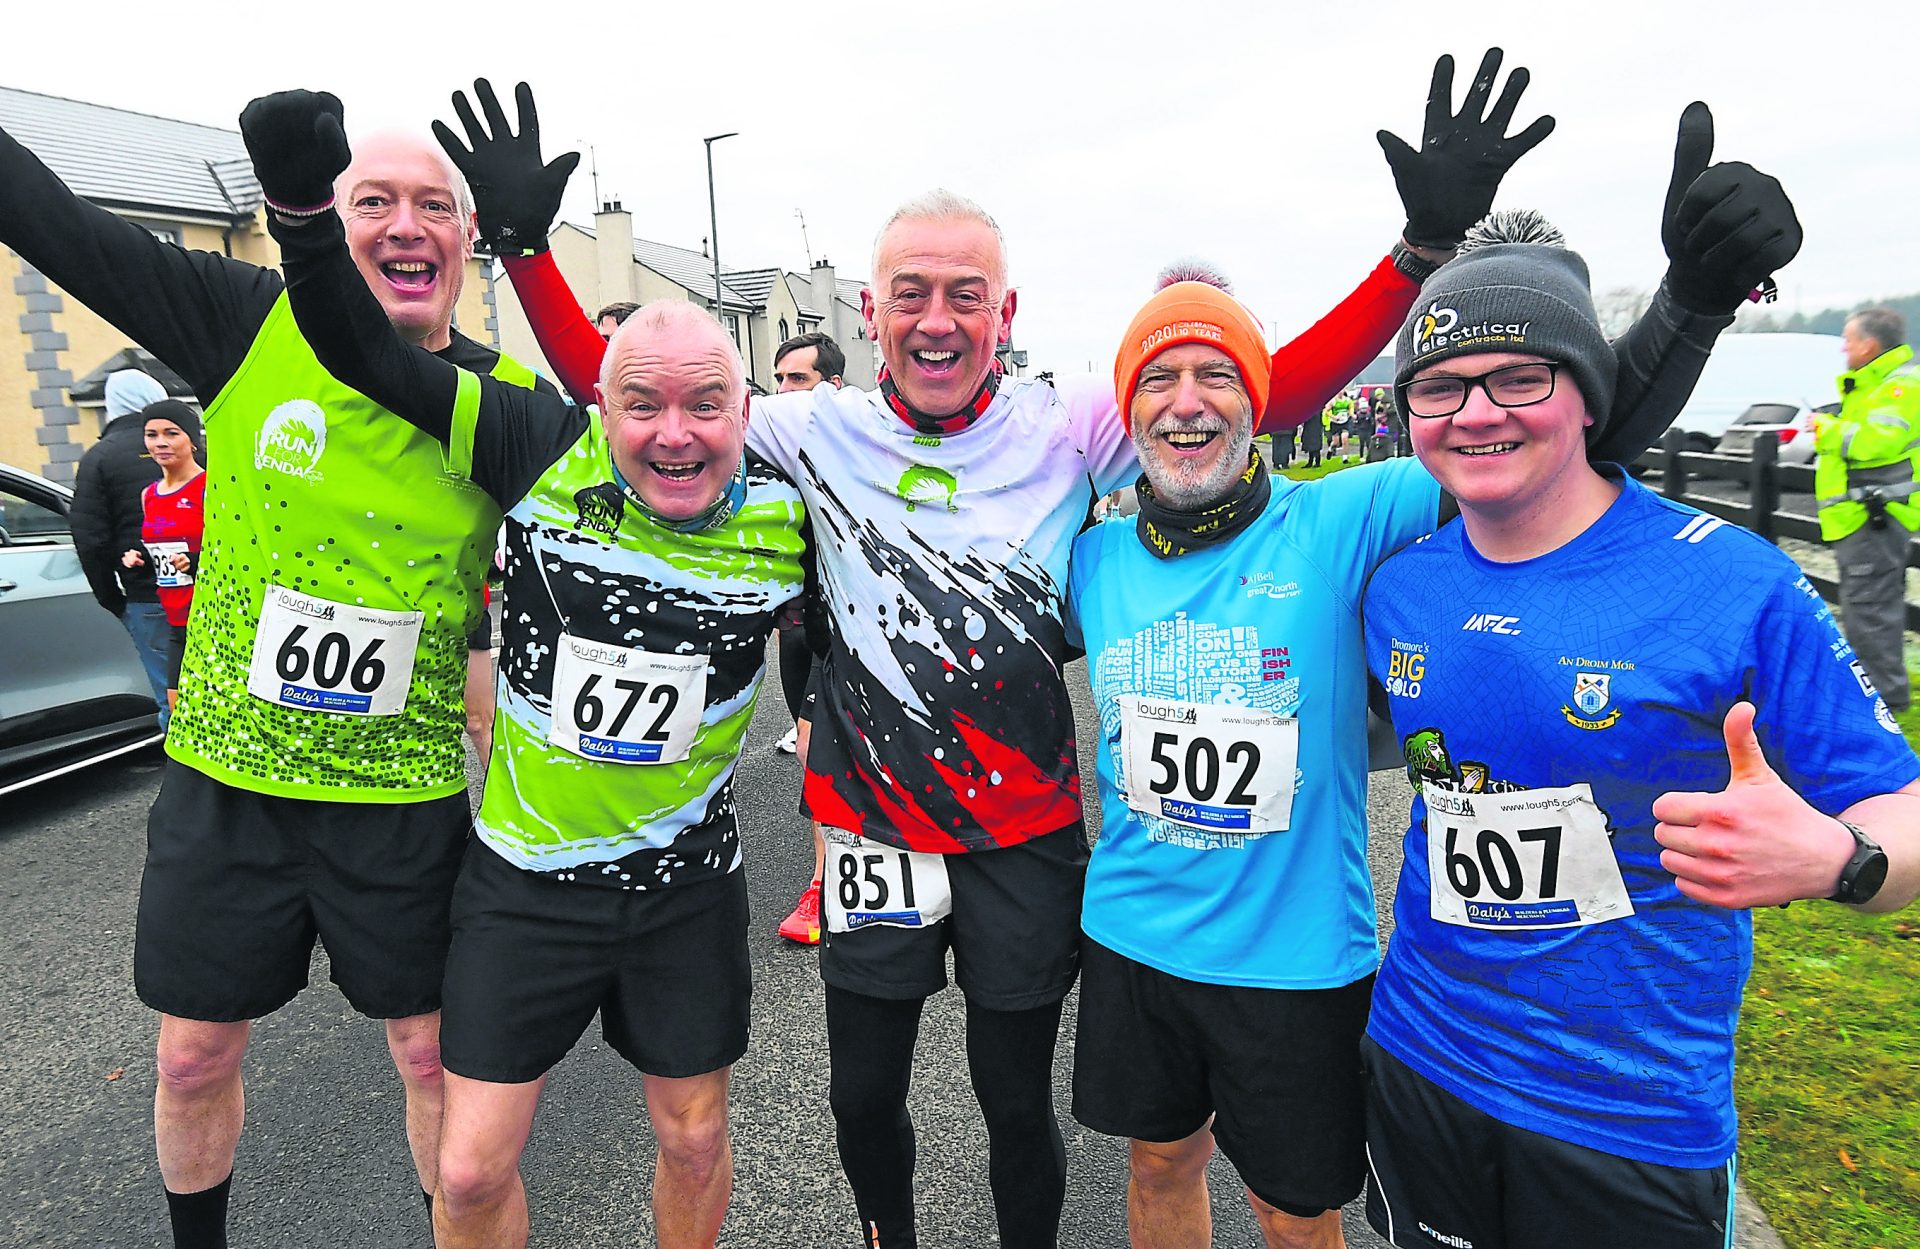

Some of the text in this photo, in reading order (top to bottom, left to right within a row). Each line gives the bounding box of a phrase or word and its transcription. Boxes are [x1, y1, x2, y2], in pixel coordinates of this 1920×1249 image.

[1141, 326, 1172, 353] 2020
[1179, 327, 1222, 341] 10 YEARS
[1421, 316, 1531, 352] electrical
[1457, 334, 1525, 348] contracts ltd
[270, 428, 314, 457] RUN
[273, 446, 303, 465] FOR
[261, 455, 304, 479] ENDA
[583, 502, 618, 521] RUN
[580, 516, 615, 536] ENDA
[1247, 581, 1298, 598] great north
[278, 591, 323, 613] lough5
[358, 616, 417, 627] www.lough5.com
[1117, 638, 1133, 647] WE
[1195, 629, 1230, 639] COME
[570, 641, 616, 662] lough5
[1107, 647, 1133, 657] RUN
[1195, 636, 1231, 652] ON
[1261, 647, 1289, 658] FIN
[1391, 637, 1430, 654] Dromore's
[275, 624, 386, 694] 606
[1106, 656, 1133, 667] FOR
[1134, 630, 1144, 692] WAVING
[1196, 650, 1261, 660] EVERY ONE
[1196, 657, 1261, 669] OF US IS
[1105, 666, 1133, 675] EACH
[1196, 666, 1261, 677] A STORY
[1262, 658, 1291, 670] ISH
[1388, 650, 1426, 682] BIG
[1202, 674, 1262, 684] ADRENALINE
[1263, 671, 1286, 681] ER
[283, 687, 320, 704] Daly's
[1385, 676, 1421, 699] SOLO
[573, 673, 679, 742] 672
[1137, 701, 1184, 721] lough5
[1221, 716, 1291, 728] www.lough5.com
[1581, 721, 1600, 729] 1933
[580, 738, 615, 755] Daly's
[1149, 731, 1262, 806] 502
[1163, 802, 1198, 819] Daly's
[1429, 794, 1461, 813] ough5
[1445, 825, 1563, 901] 607
[838, 852, 916, 911] 851
[1468, 905, 1512, 921] Daly's
